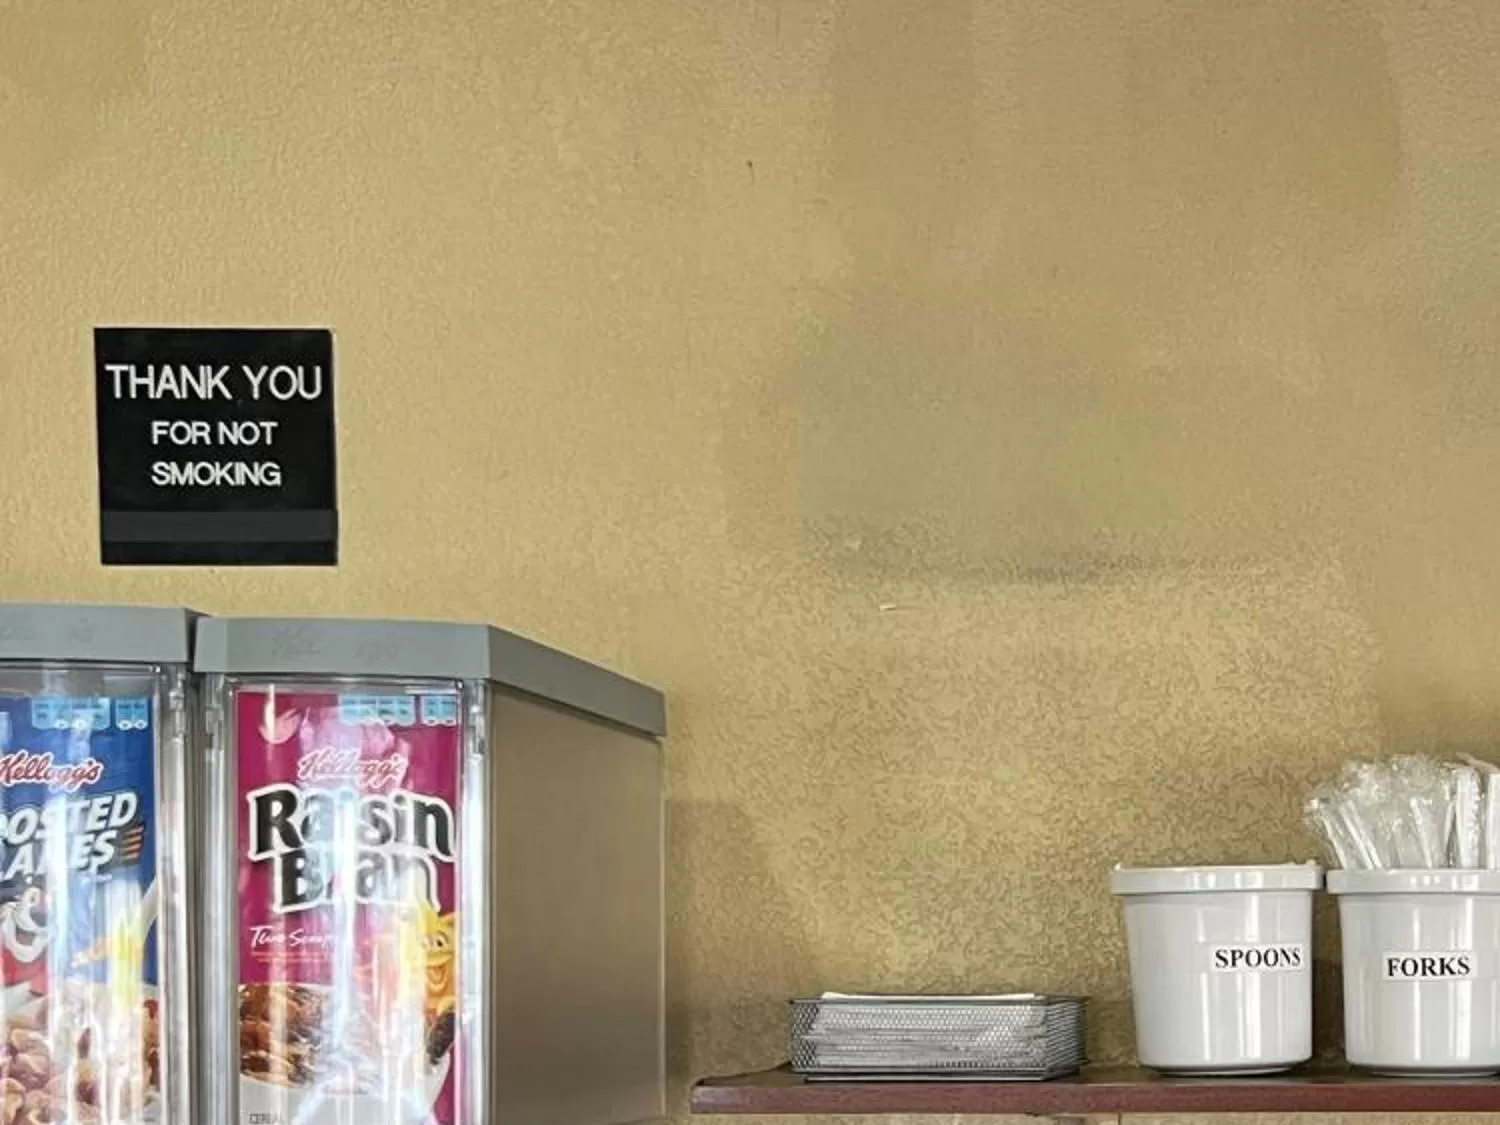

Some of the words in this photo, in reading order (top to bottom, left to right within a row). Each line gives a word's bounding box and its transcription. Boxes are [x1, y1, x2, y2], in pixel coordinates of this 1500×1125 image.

[105, 364, 232, 400] THANK
[242, 365, 323, 400] YOU
[151, 421, 212, 446] FOR
[218, 421, 279, 446] NOT
[151, 461, 282, 487] SMOKING
[1215, 946, 1301, 969] SPOONS
[1386, 956, 1470, 977] FORKS
